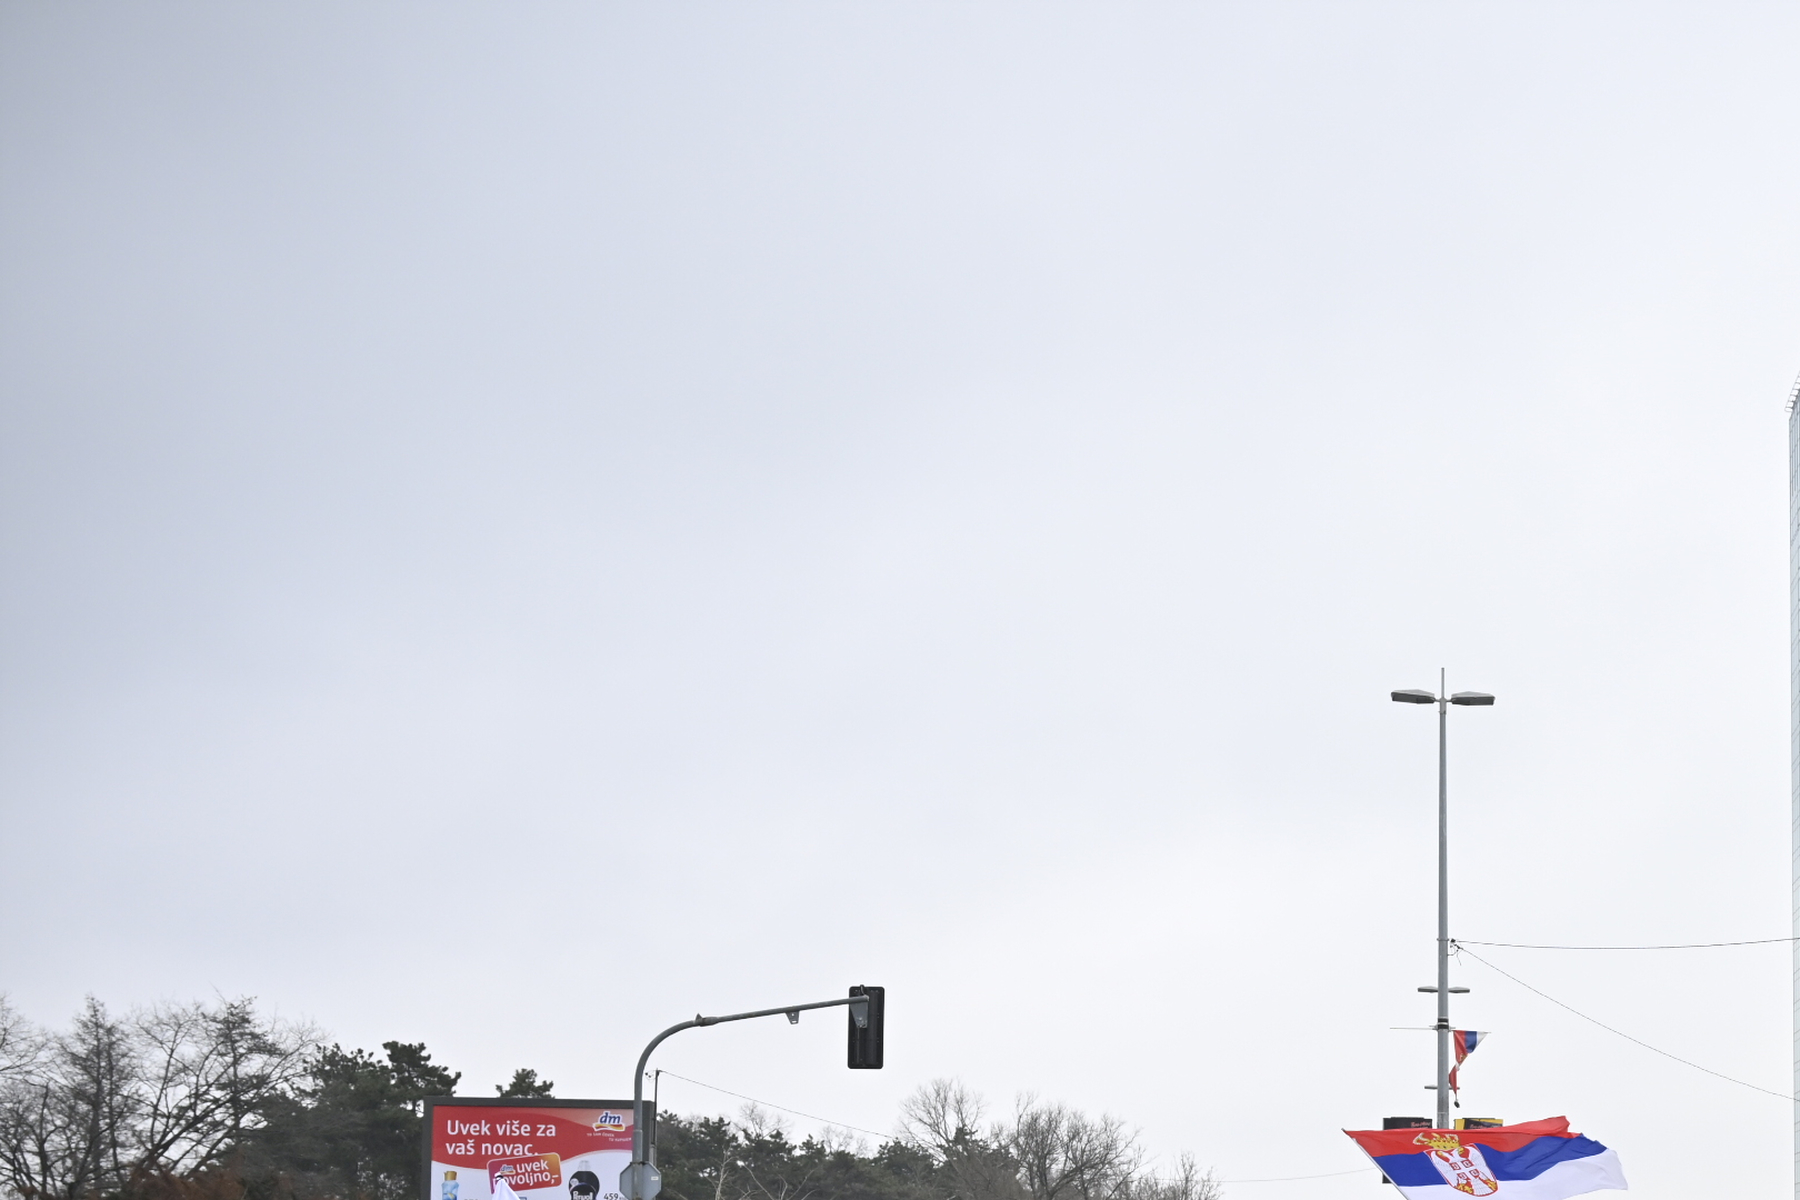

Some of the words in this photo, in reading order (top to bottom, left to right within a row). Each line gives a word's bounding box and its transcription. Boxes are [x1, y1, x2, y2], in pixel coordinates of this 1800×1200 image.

[599, 1111, 621, 1124] dm
[447, 1119, 491, 1136] Uvek
[496, 1120, 531, 1136] više
[536, 1124, 556, 1136] za
[445, 1139, 475, 1155] vaš
[481, 1142, 539, 1156] novac.
[517, 1159, 549, 1173] uvek
[603, 1193, 619, 1200] 459
